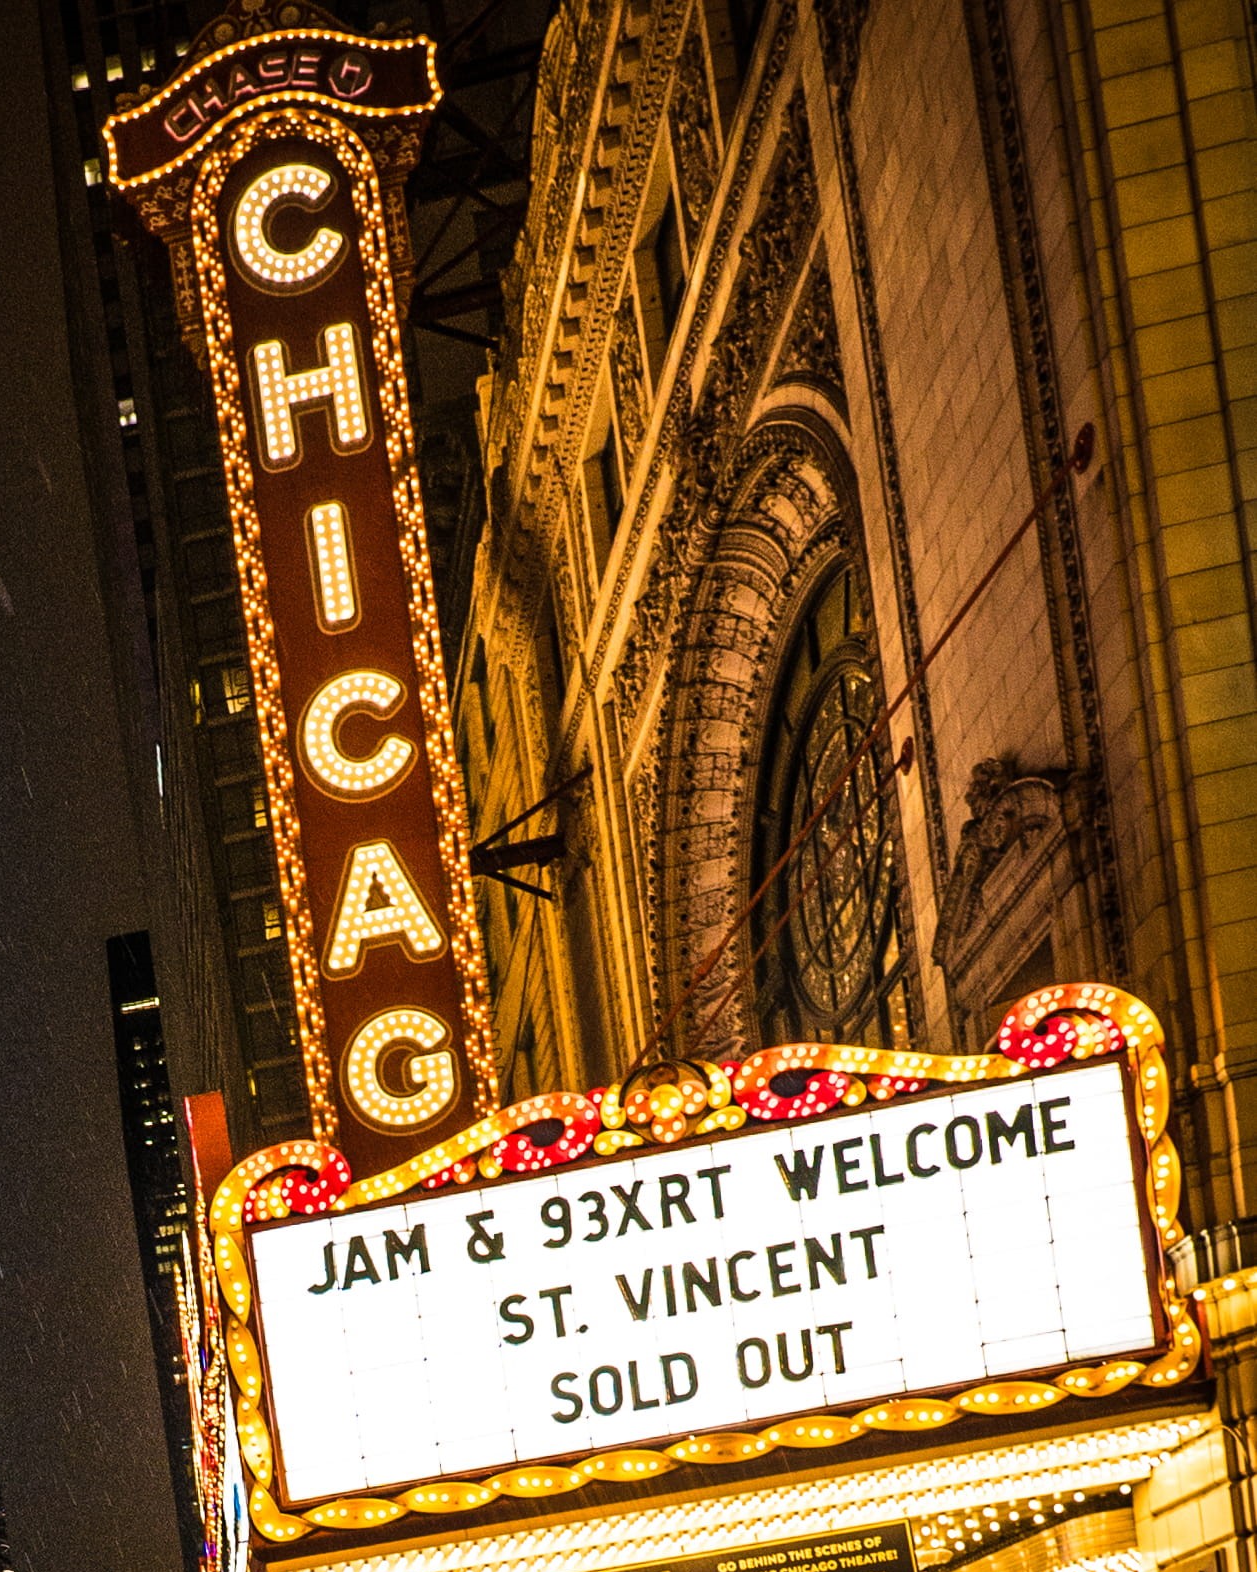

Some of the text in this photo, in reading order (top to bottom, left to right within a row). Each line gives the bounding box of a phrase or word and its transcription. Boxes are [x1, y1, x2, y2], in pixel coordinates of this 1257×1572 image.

[165, 48, 322, 141] CHASE
[307, 1096, 1076, 1295] JAM & 93XRT WELCOME
[498, 1224, 885, 1345] ST. VINCENT
[550, 1321, 853, 1424] SOLD OUT
[739, 1553, 787, 1571] BEHIND
[787, 1548, 813, 1562] THE
[814, 1539, 862, 1558] SCENES
[863, 1536, 883, 1549] OF
[838, 1549, 899, 1569] THEATRE!
